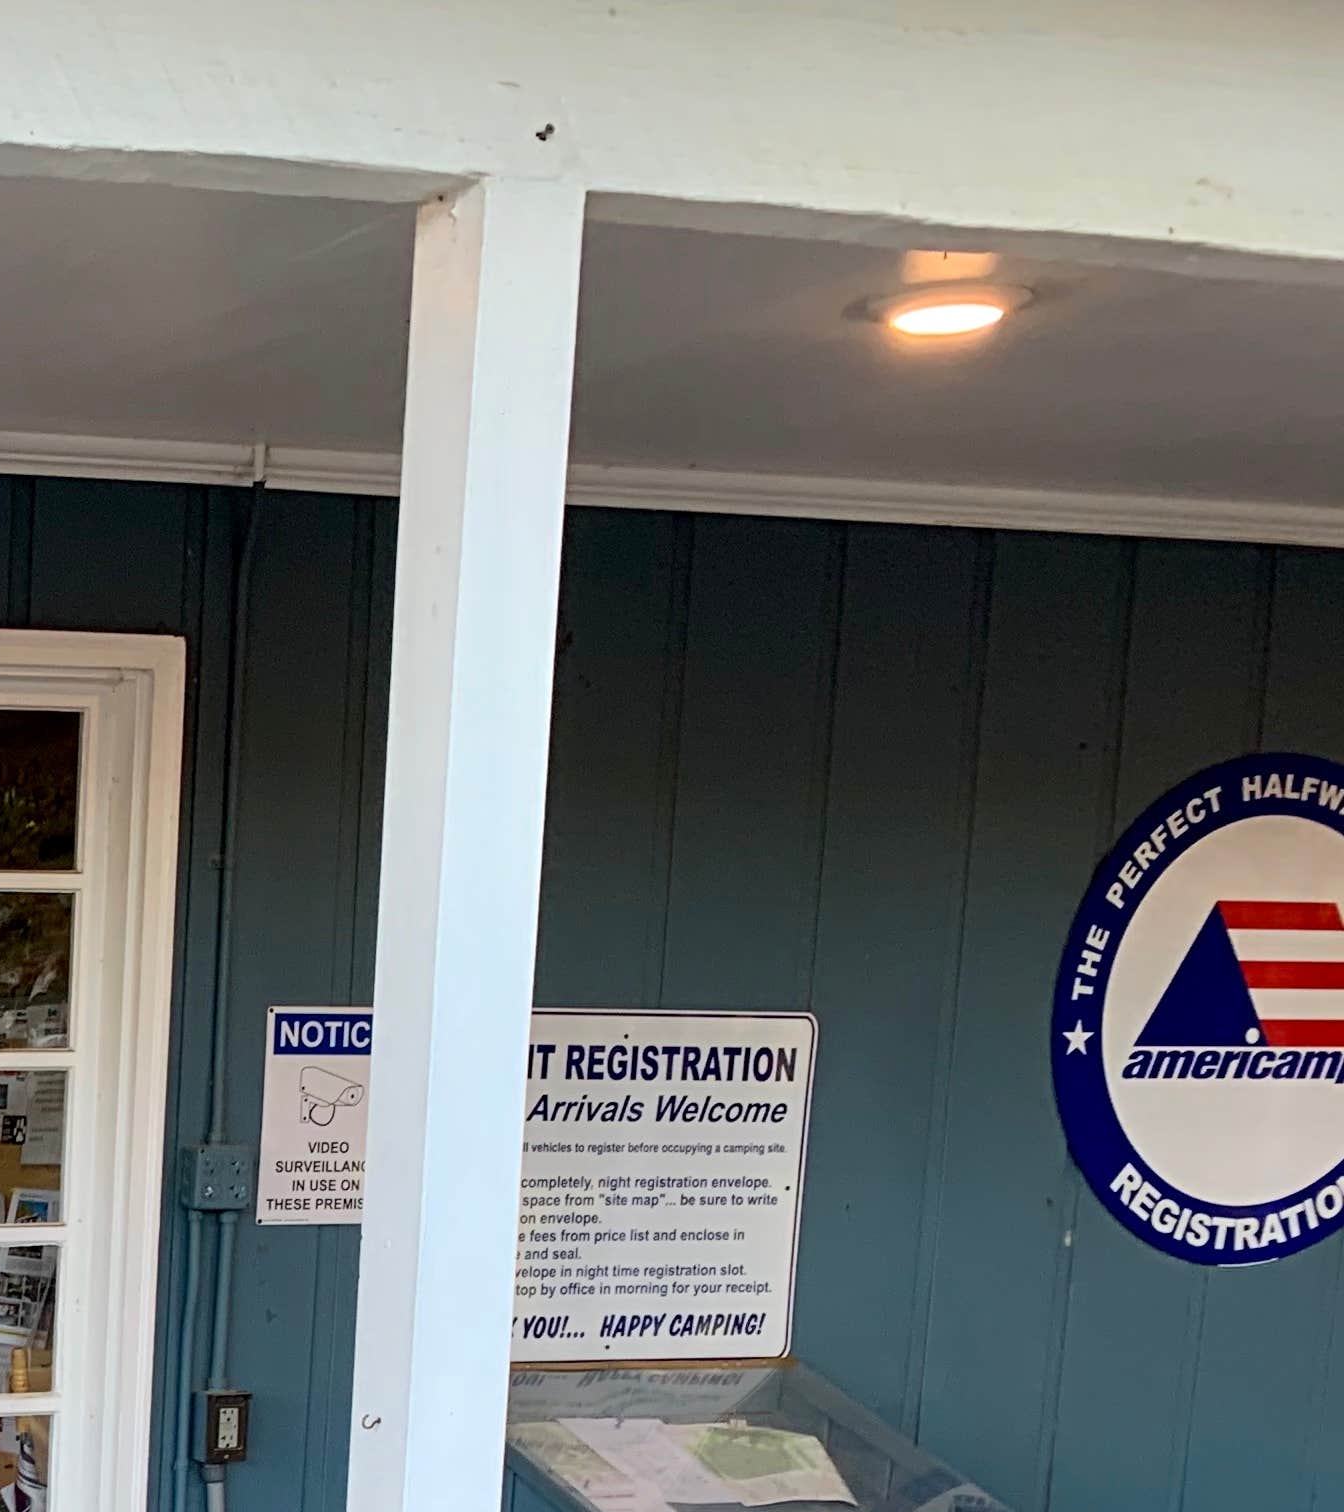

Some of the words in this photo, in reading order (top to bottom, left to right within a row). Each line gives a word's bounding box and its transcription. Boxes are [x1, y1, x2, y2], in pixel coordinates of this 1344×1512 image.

[1071, 924, 1111, 1000] THE
[1105, 785, 1225, 910] PERFECT
[1241, 772, 1344, 816] HALFW
[278, 1019, 372, 1049] NOTIC
[564, 1044, 798, 1082] REGISTRATION
[526, 1094, 645, 1123] Arrivals
[654, 1094, 789, 1124] Welcome
[307, 1140, 350, 1155] VIDEO
[531, 1142, 572, 1154] vehicles
[575, 1143, 585, 1154] to
[587, 1142, 625, 1156] register
[627, 1142, 659, 1154] before
[661, 1143, 712, 1157] occupying
[715, 1144, 721, 1154] a
[722, 1142, 765, 1156] camping
[274, 1160, 367, 1174] SURVEILLAN
[291, 1179, 306, 1193] IN
[309, 1179, 337, 1193] USE
[340, 1179, 361, 1193] ON
[520, 1175, 594, 1192] completely,
[597, 1175, 631, 1191] night
[634, 1175, 708, 1191] registration
[711, 1175, 773, 1191] envelope.
[265, 1197, 311, 1211] THESE
[314, 1197, 365, 1211] PREMIS
[521, 1193, 561, 1209] space
[564, 1192, 595, 1207] from
[679, 1192, 697, 1206] be
[698, 1195, 729, 1206] sure
[731, 1193, 745, 1206] to
[747, 1193, 779, 1206] write
[519, 1214, 537, 1226] on
[539, 1212, 603, 1226] envelope.
[529, 1230, 559, 1243] fees
[561, 1230, 591, 1243] from
[593, 1229, 627, 1245] price
[629, 1229, 650, 1242] list
[652, 1229, 678, 1242] and
[679, 1228, 731, 1242] enclose
[733, 1228, 746, 1241] in
[524, 1247, 550, 1260] and
[552, 1247, 582, 1260] seal.
[514, 1264, 557, 1280] velope
[560, 1264, 573, 1278] in
[575, 1264, 610, 1280] night
[612, 1263, 640, 1277] time
[643, 1263, 717, 1280] registration
[720, 1263, 747, 1277] slot.
[515, 1283, 538, 1298] top
[540, 1282, 556, 1299] by
[559, 1282, 596, 1296] office
[598, 1282, 612, 1296] in
[614, 1281, 668, 1297] morning
[671, 1281, 691, 1295] for
[692, 1283, 723, 1297] your
[724, 1280, 774, 1296] receipt.
[521, 1313, 587, 1340] YOU!...
[598, 1312, 667, 1339] HAPPY
[668, 1311, 768, 1338] CAMPING!
